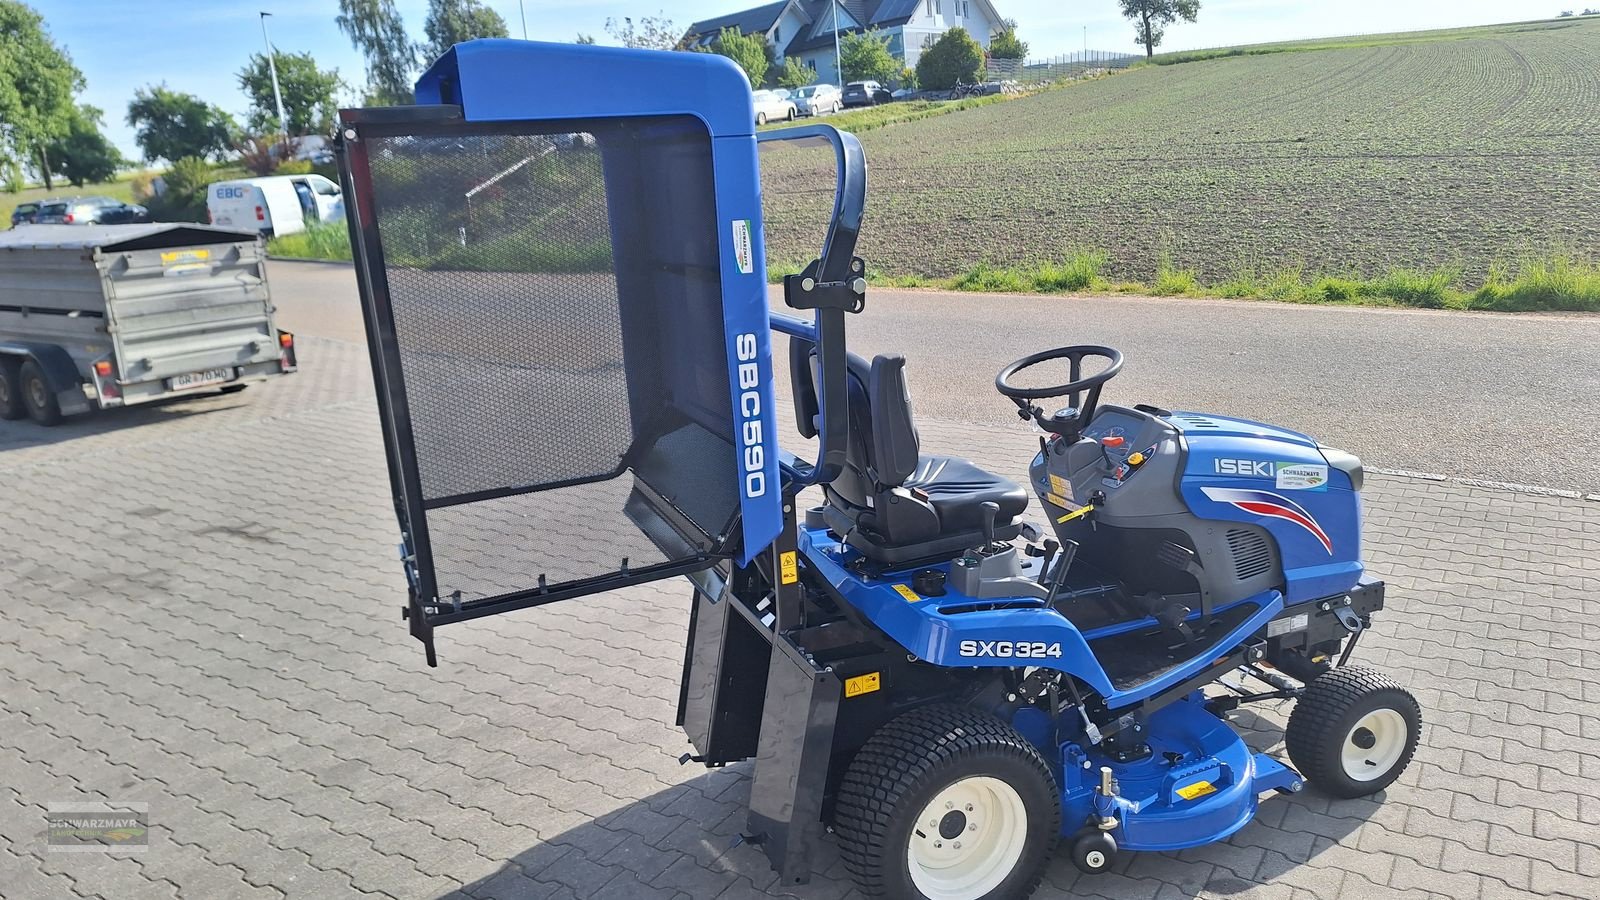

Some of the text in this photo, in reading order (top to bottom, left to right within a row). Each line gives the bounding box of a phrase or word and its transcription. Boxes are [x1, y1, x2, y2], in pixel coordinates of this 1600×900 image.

[216, 187, 243, 199] EBG
[736, 333, 765, 498] SBC590
[1214, 458, 1274, 477] ISEKI
[1282, 469, 1320, 477] SCHWARZMAYR
[959, 639, 1062, 658] SXG324
